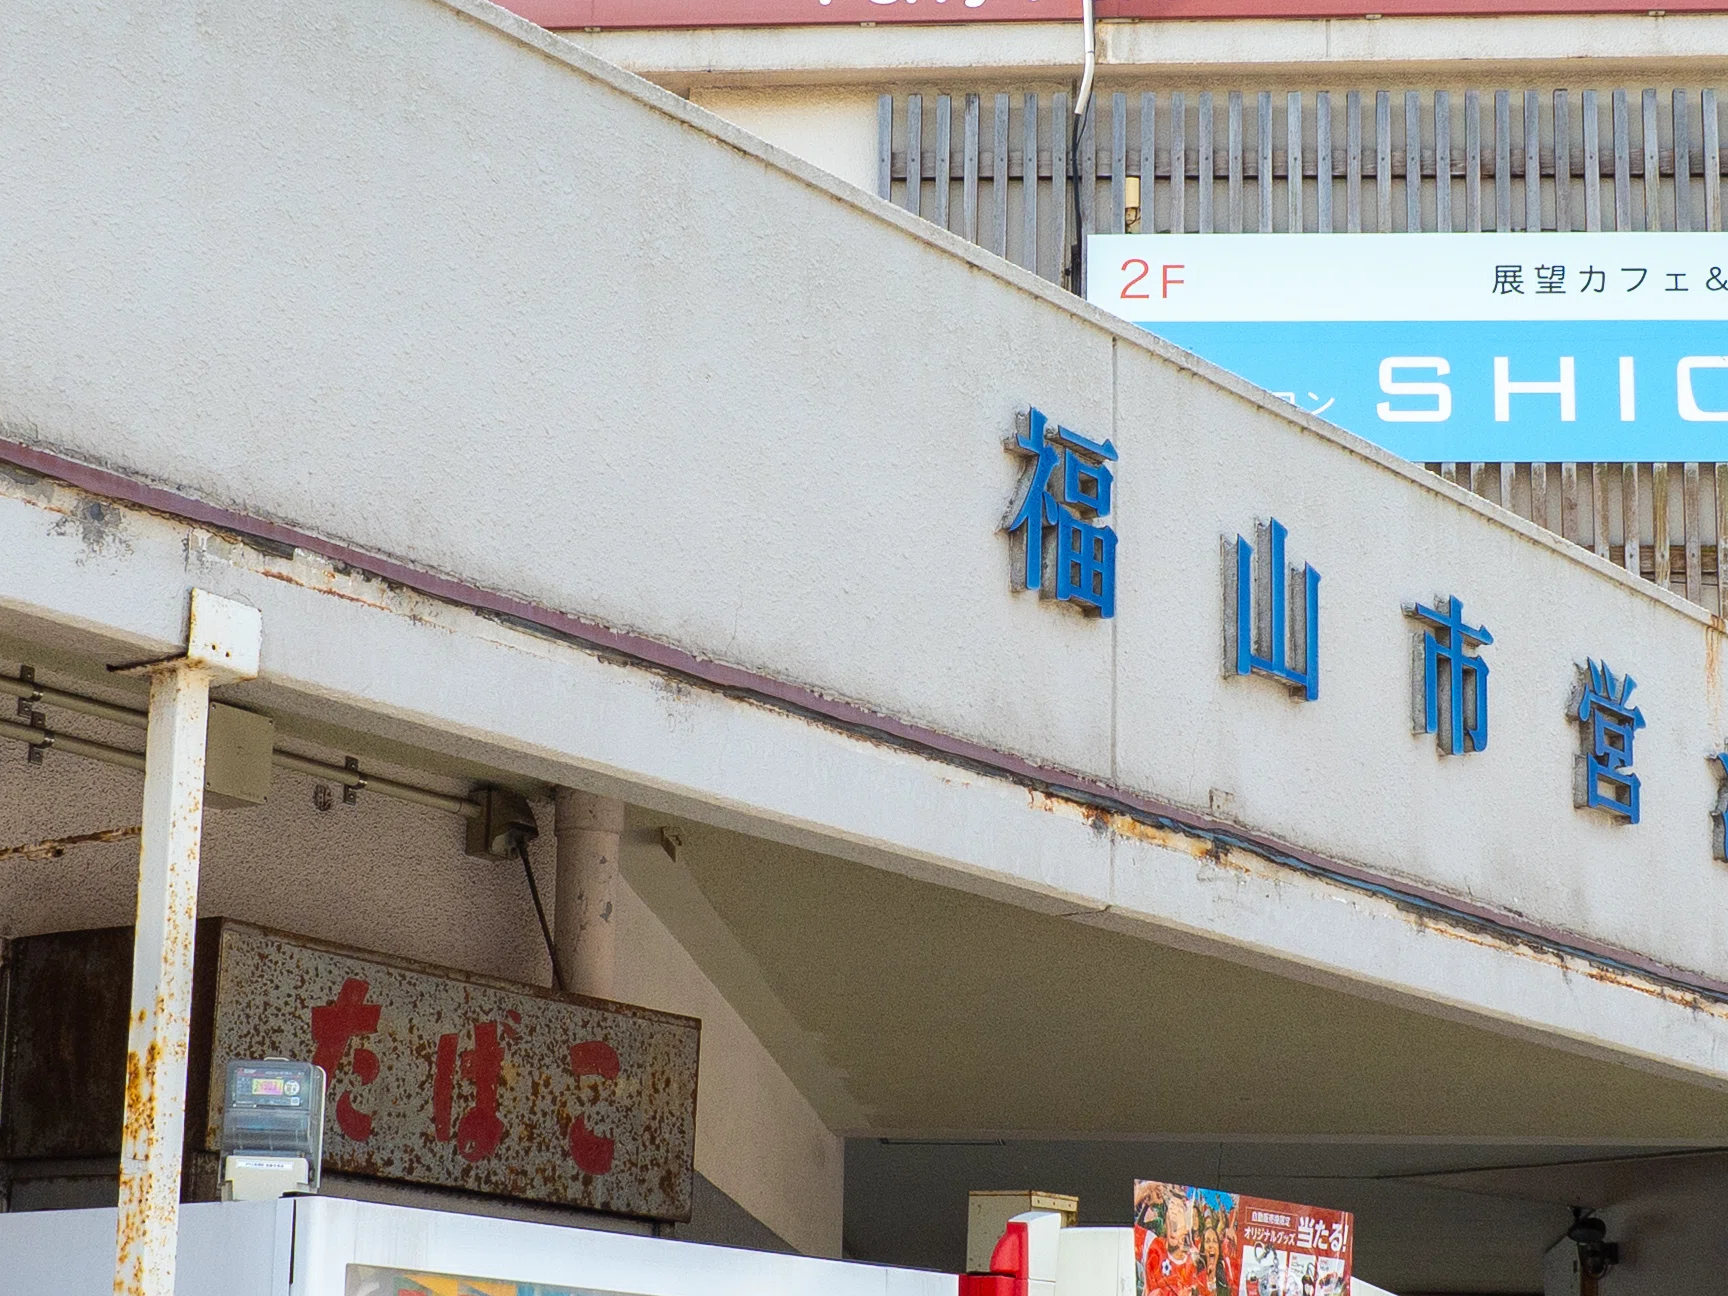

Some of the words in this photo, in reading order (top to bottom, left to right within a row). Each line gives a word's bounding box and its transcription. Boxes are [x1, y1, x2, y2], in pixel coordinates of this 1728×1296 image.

[1119, 258, 1186, 301] 2F
[311, 976, 620, 1177] たばこ
[1296, 1215, 1349, 1253] 当たる!
